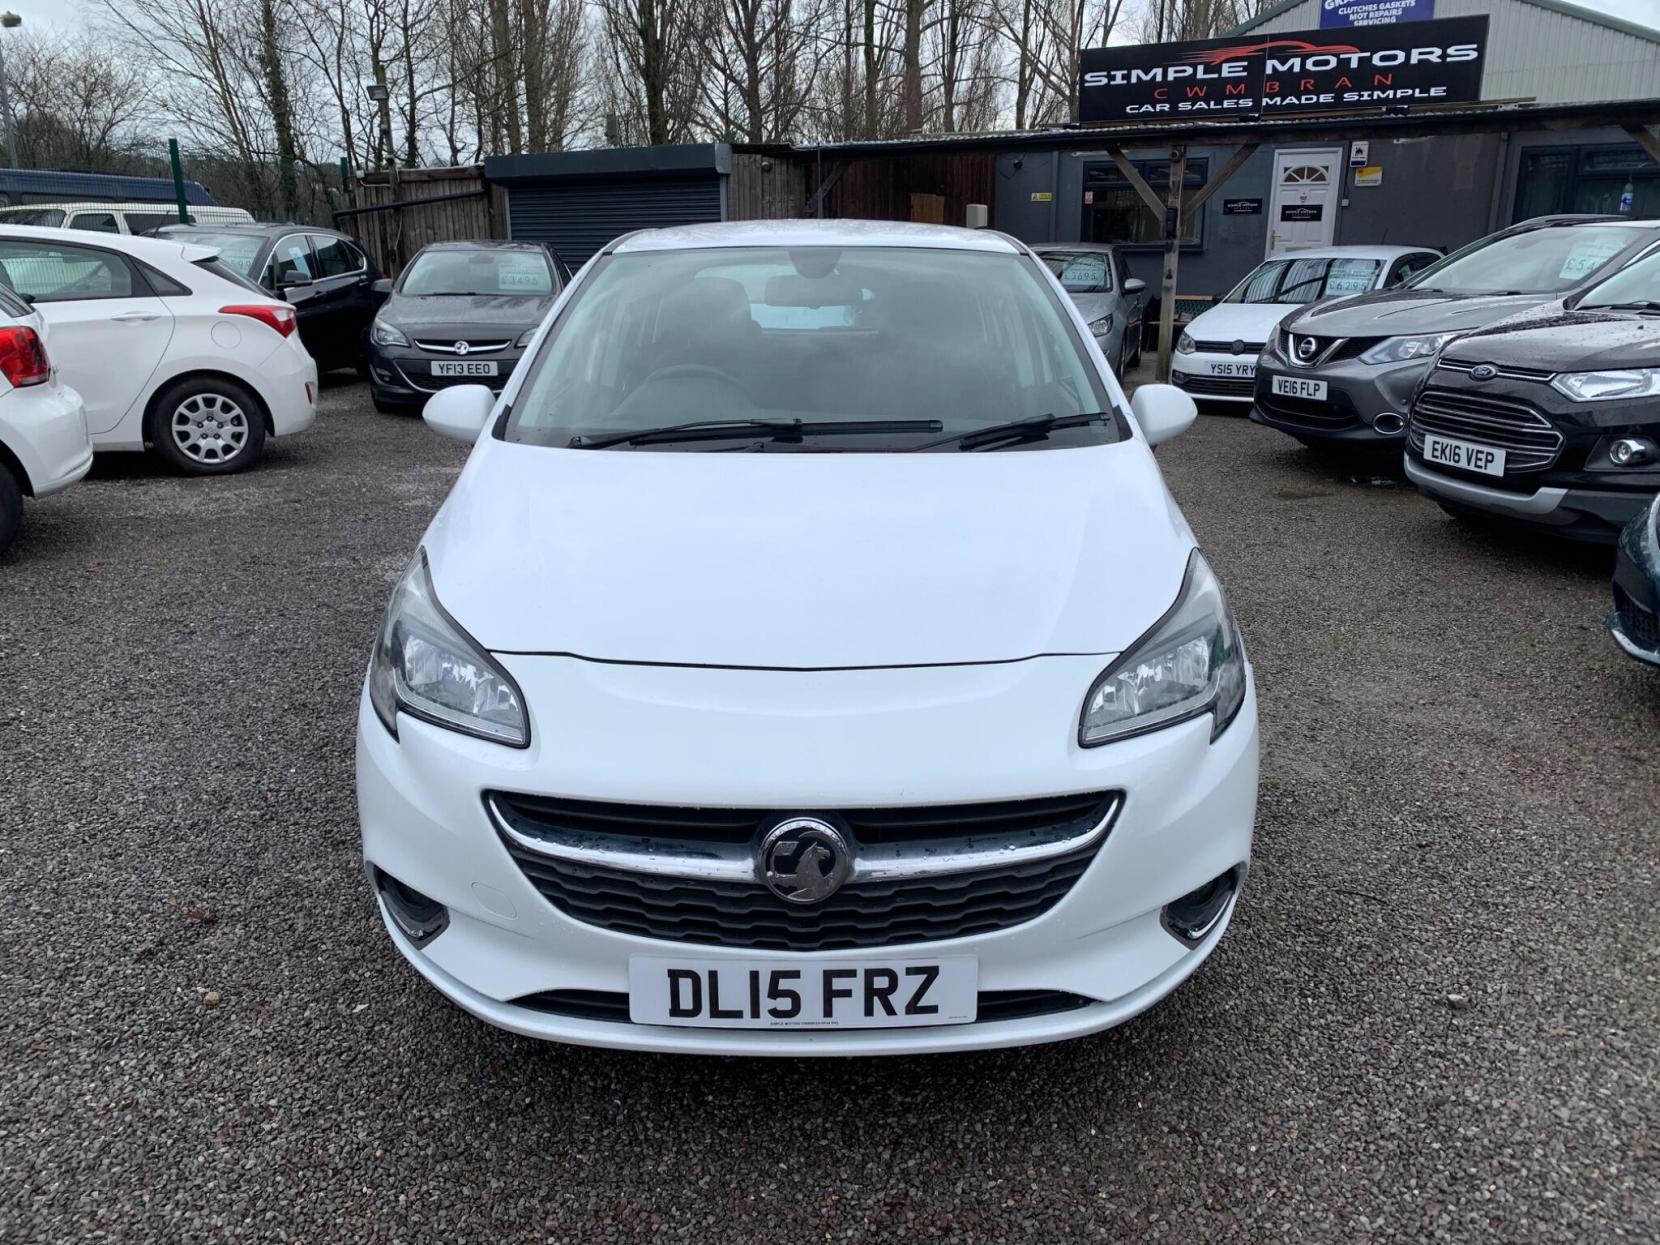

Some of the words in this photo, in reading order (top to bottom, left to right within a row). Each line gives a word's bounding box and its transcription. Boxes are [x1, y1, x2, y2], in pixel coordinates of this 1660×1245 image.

[1338, 3, 1378, 15] CLUTCHES
[1379, 0, 1416, 10] GASKETS
[1349, 12, 1368, 21] MOT
[1369, 8, 1403, 19] REPAIRS
[1354, 16, 1397, 26] SERVICING
[1084, 61, 1248, 87] SIMPLE
[1265, 44, 1479, 75] MOTORS
[1154, 73, 1393, 99] CWMBRAN
[1126, 103, 1171, 114] CAR
[1178, 98, 1253, 111] SALES
[1261, 93, 1335, 106] MADE
[1343, 86, 1447, 101] SIMPLE
[1329, 281, 1367, 291] £6295
[438, 363, 464, 374] YF13
[467, 363, 490, 374] EEO
[1210, 363, 1233, 375] YS15
[1236, 364, 1256, 376] YRY
[1278, 379, 1298, 394] VE16
[1300, 381, 1321, 397] FLP
[1431, 440, 1461, 464] EK16
[1466, 447, 1495, 470] VEP
[667, 968, 801, 1019] DL15
[822, 965, 940, 1018] FRZ
